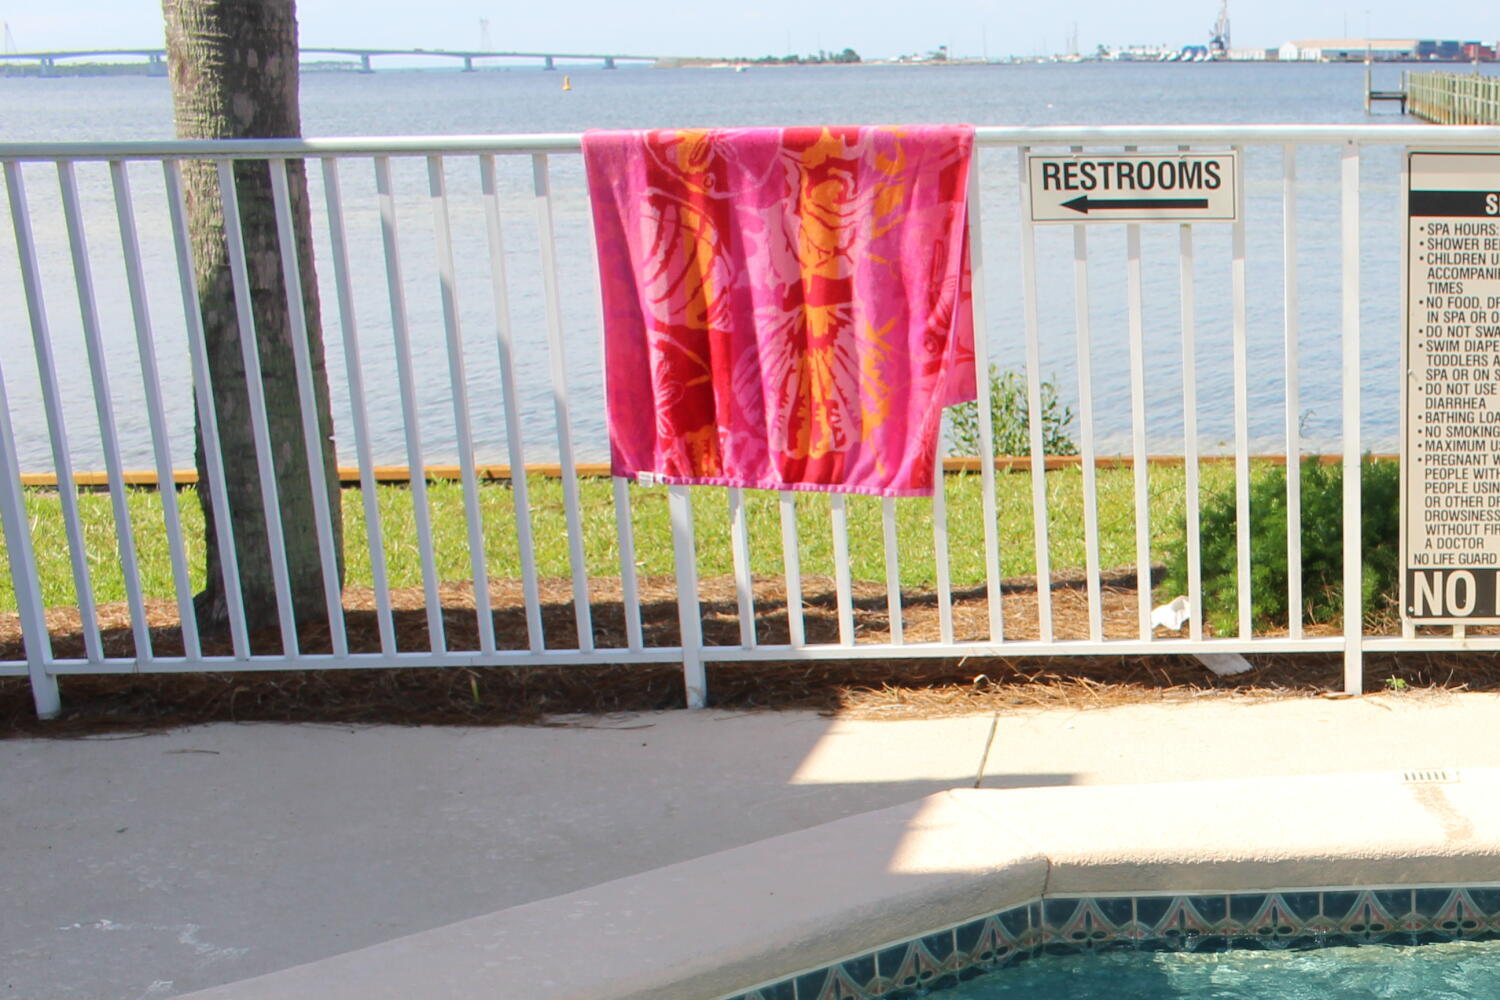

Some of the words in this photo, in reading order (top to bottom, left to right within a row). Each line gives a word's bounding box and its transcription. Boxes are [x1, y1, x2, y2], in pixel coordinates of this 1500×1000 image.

[1043, 160, 1221, 190] RESTROOMS
[1427, 223, 1450, 235] SPA
[1454, 223, 1500, 236] HOURS:
[1427, 238, 1480, 251] SHOWER
[1427, 253, 1486, 266] CHILDREN
[1427, 282, 1464, 295] TIMES
[1426, 296, 1443, 309] NO
[1447, 296, 1482, 311] FOOD,
[1427, 311, 1438, 324] IN
[1443, 311, 1466, 323] SPA
[1470, 311, 1487, 324] OR
[1426, 325, 1443, 337] DO
[1447, 325, 1471, 338] NOT
[1426, 340, 1460, 353] SWIM
[1426, 354, 1489, 366] TODDLERS
[1426, 369, 1448, 381] SPA
[1452, 369, 1469, 381] OR
[1473, 369, 1490, 381] ON
[1425, 383, 1442, 396] DO
[1446, 383, 1470, 396] NOT
[1474, 383, 1498, 396] USE
[1425, 397, 1486, 409] DIARRHEA
[1425, 411, 1475, 423] BATHING
[1425, 426, 1441, 438] NO
[1446, 426, 1500, 437] SMOKING
[1425, 440, 1486, 453] MAXIMUM
[1425, 454, 1489, 467] PREGNANT
[1424, 468, 1469, 480] PEOPLE
[1424, 482, 1469, 494] PEOPLE
[1424, 496, 1441, 508] OR
[1445, 496, 1484, 508] OTHER
[1424, 510, 1500, 521] DROWSINESS
[1425, 524, 1480, 537] WITHOUT
[1425, 538, 1432, 549] A
[1436, 537, 1484, 549] DOCTOR
[1413, 553, 1429, 565] NO
[1432, 553, 1455, 565] LIFE
[1458, 553, 1497, 565] GUARD
[1413, 570, 1476, 616] NO
